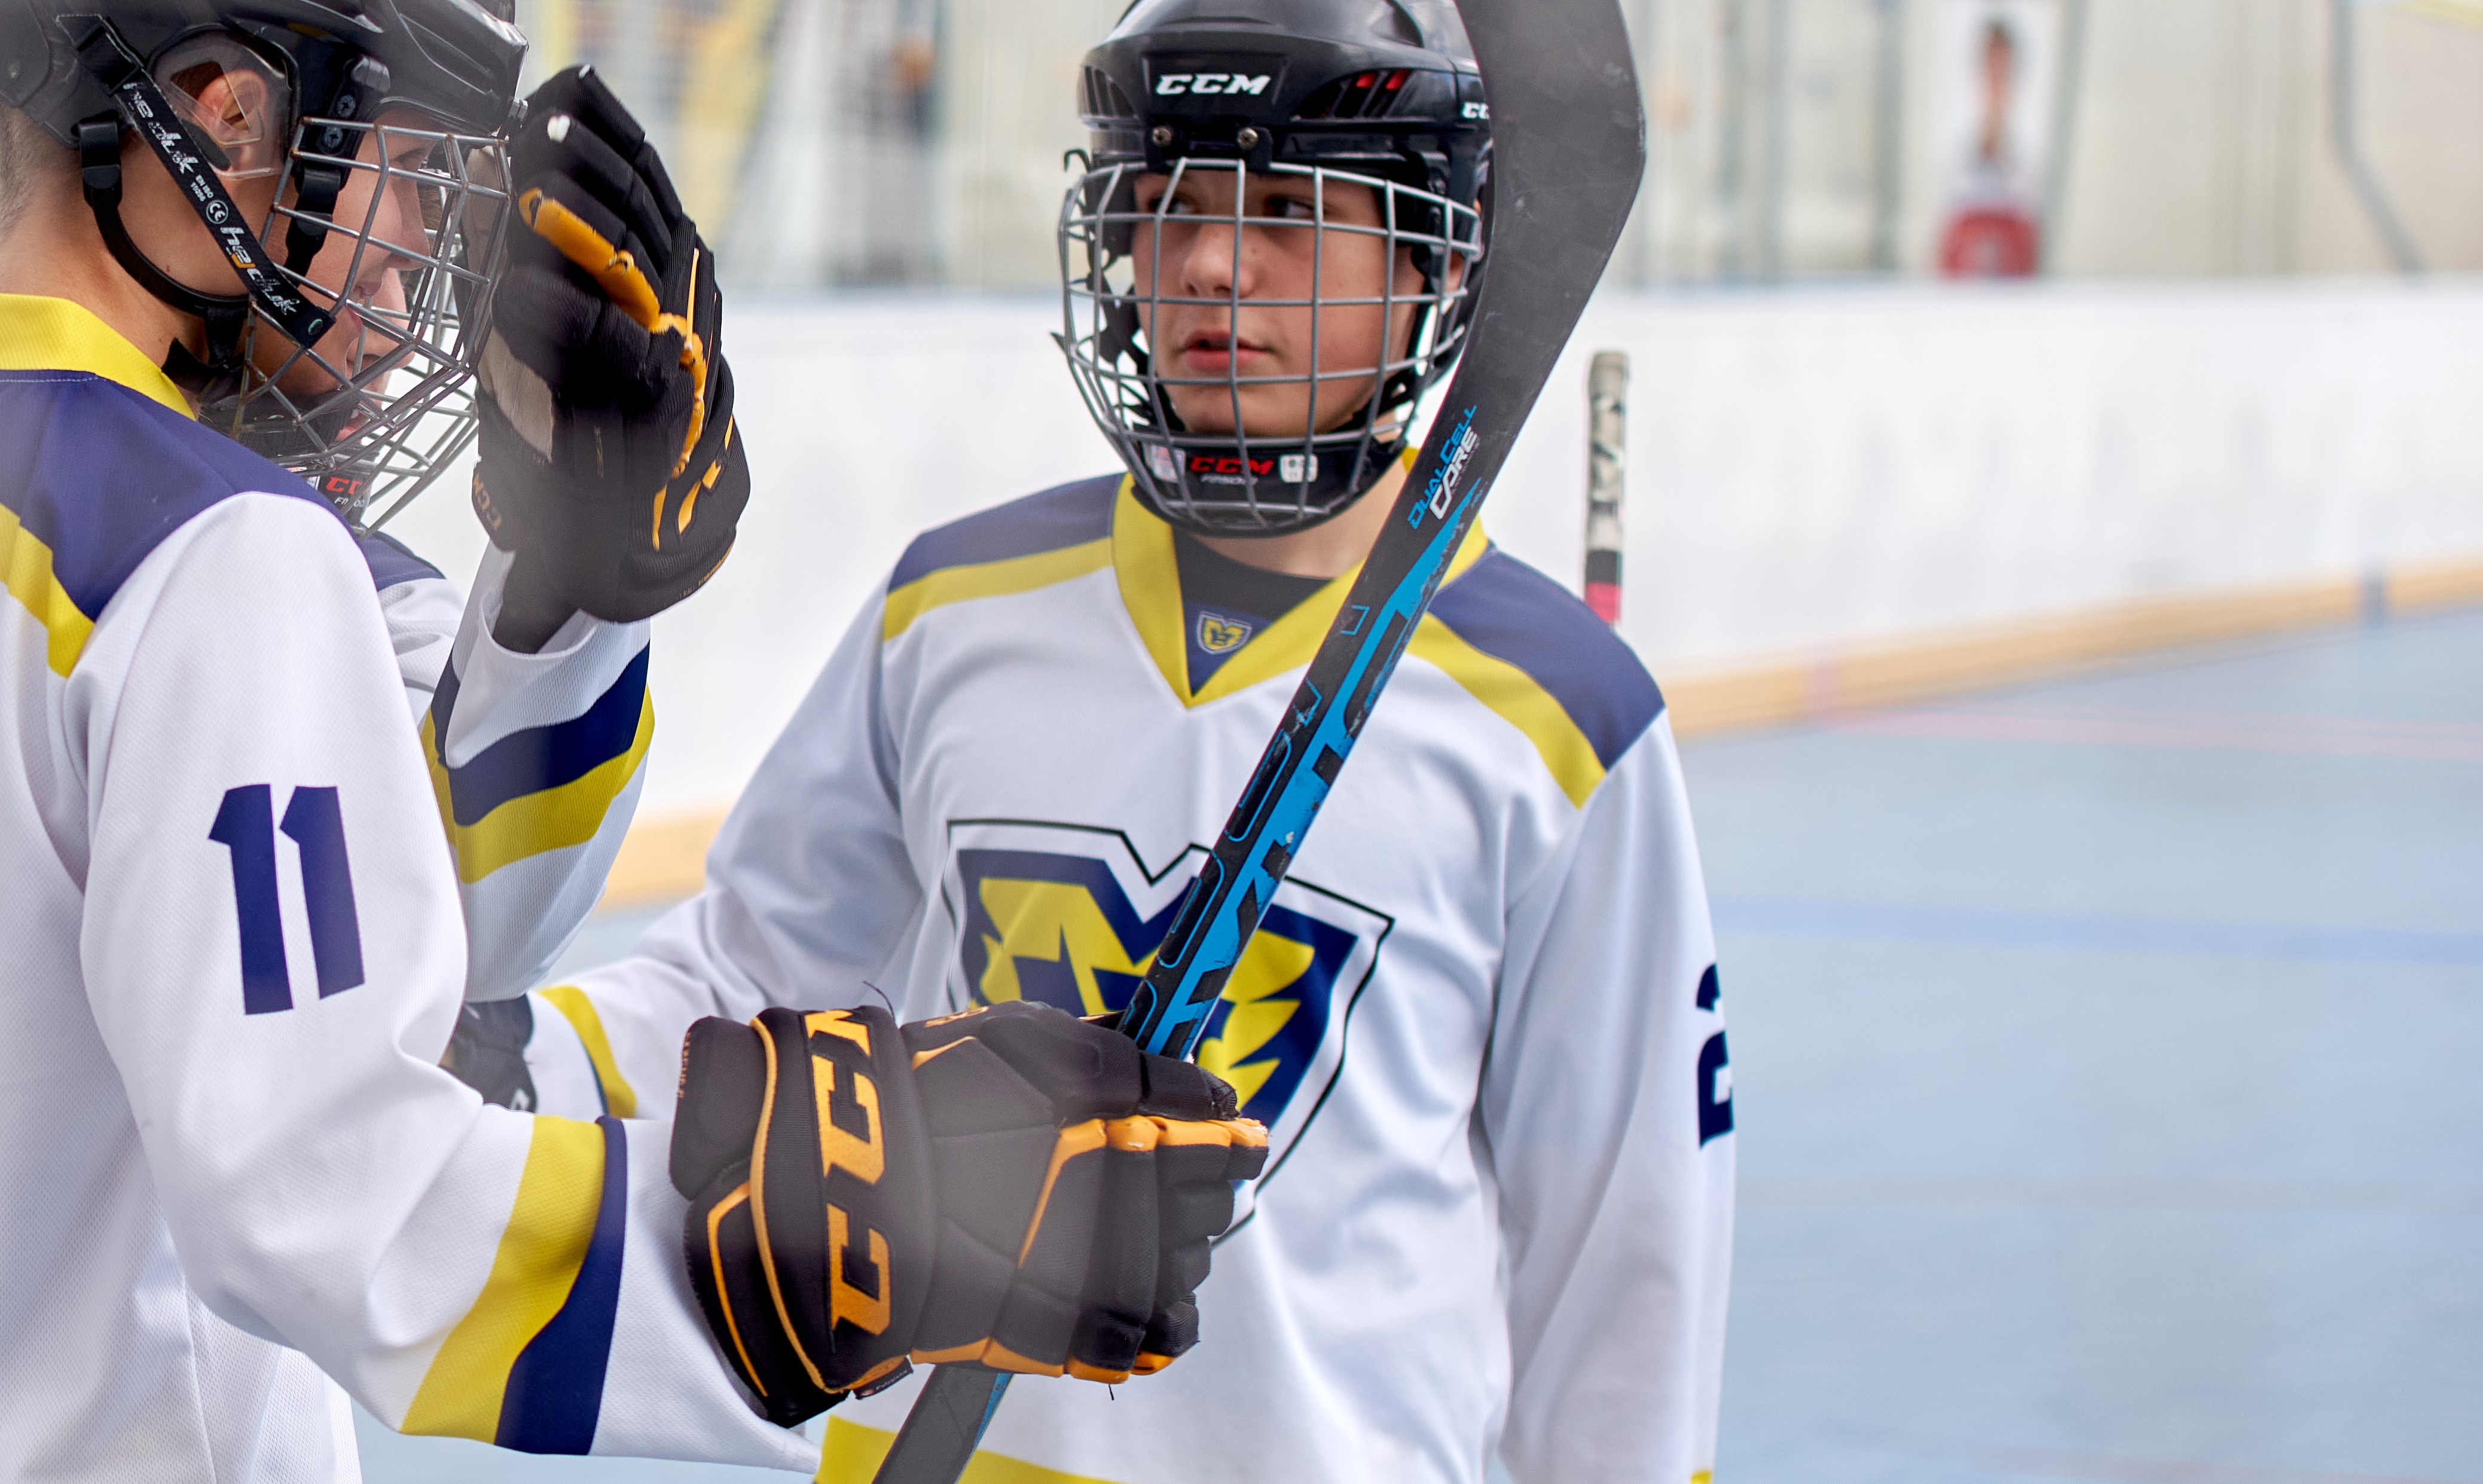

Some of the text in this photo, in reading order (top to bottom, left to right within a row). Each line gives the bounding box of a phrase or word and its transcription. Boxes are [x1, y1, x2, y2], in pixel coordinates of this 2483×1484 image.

[1156, 74, 1271, 95] CCM
[1190, 456, 1274, 475] CCM
[1429, 426, 1478, 520] CORE
[207, 783, 365, 1015] 11
